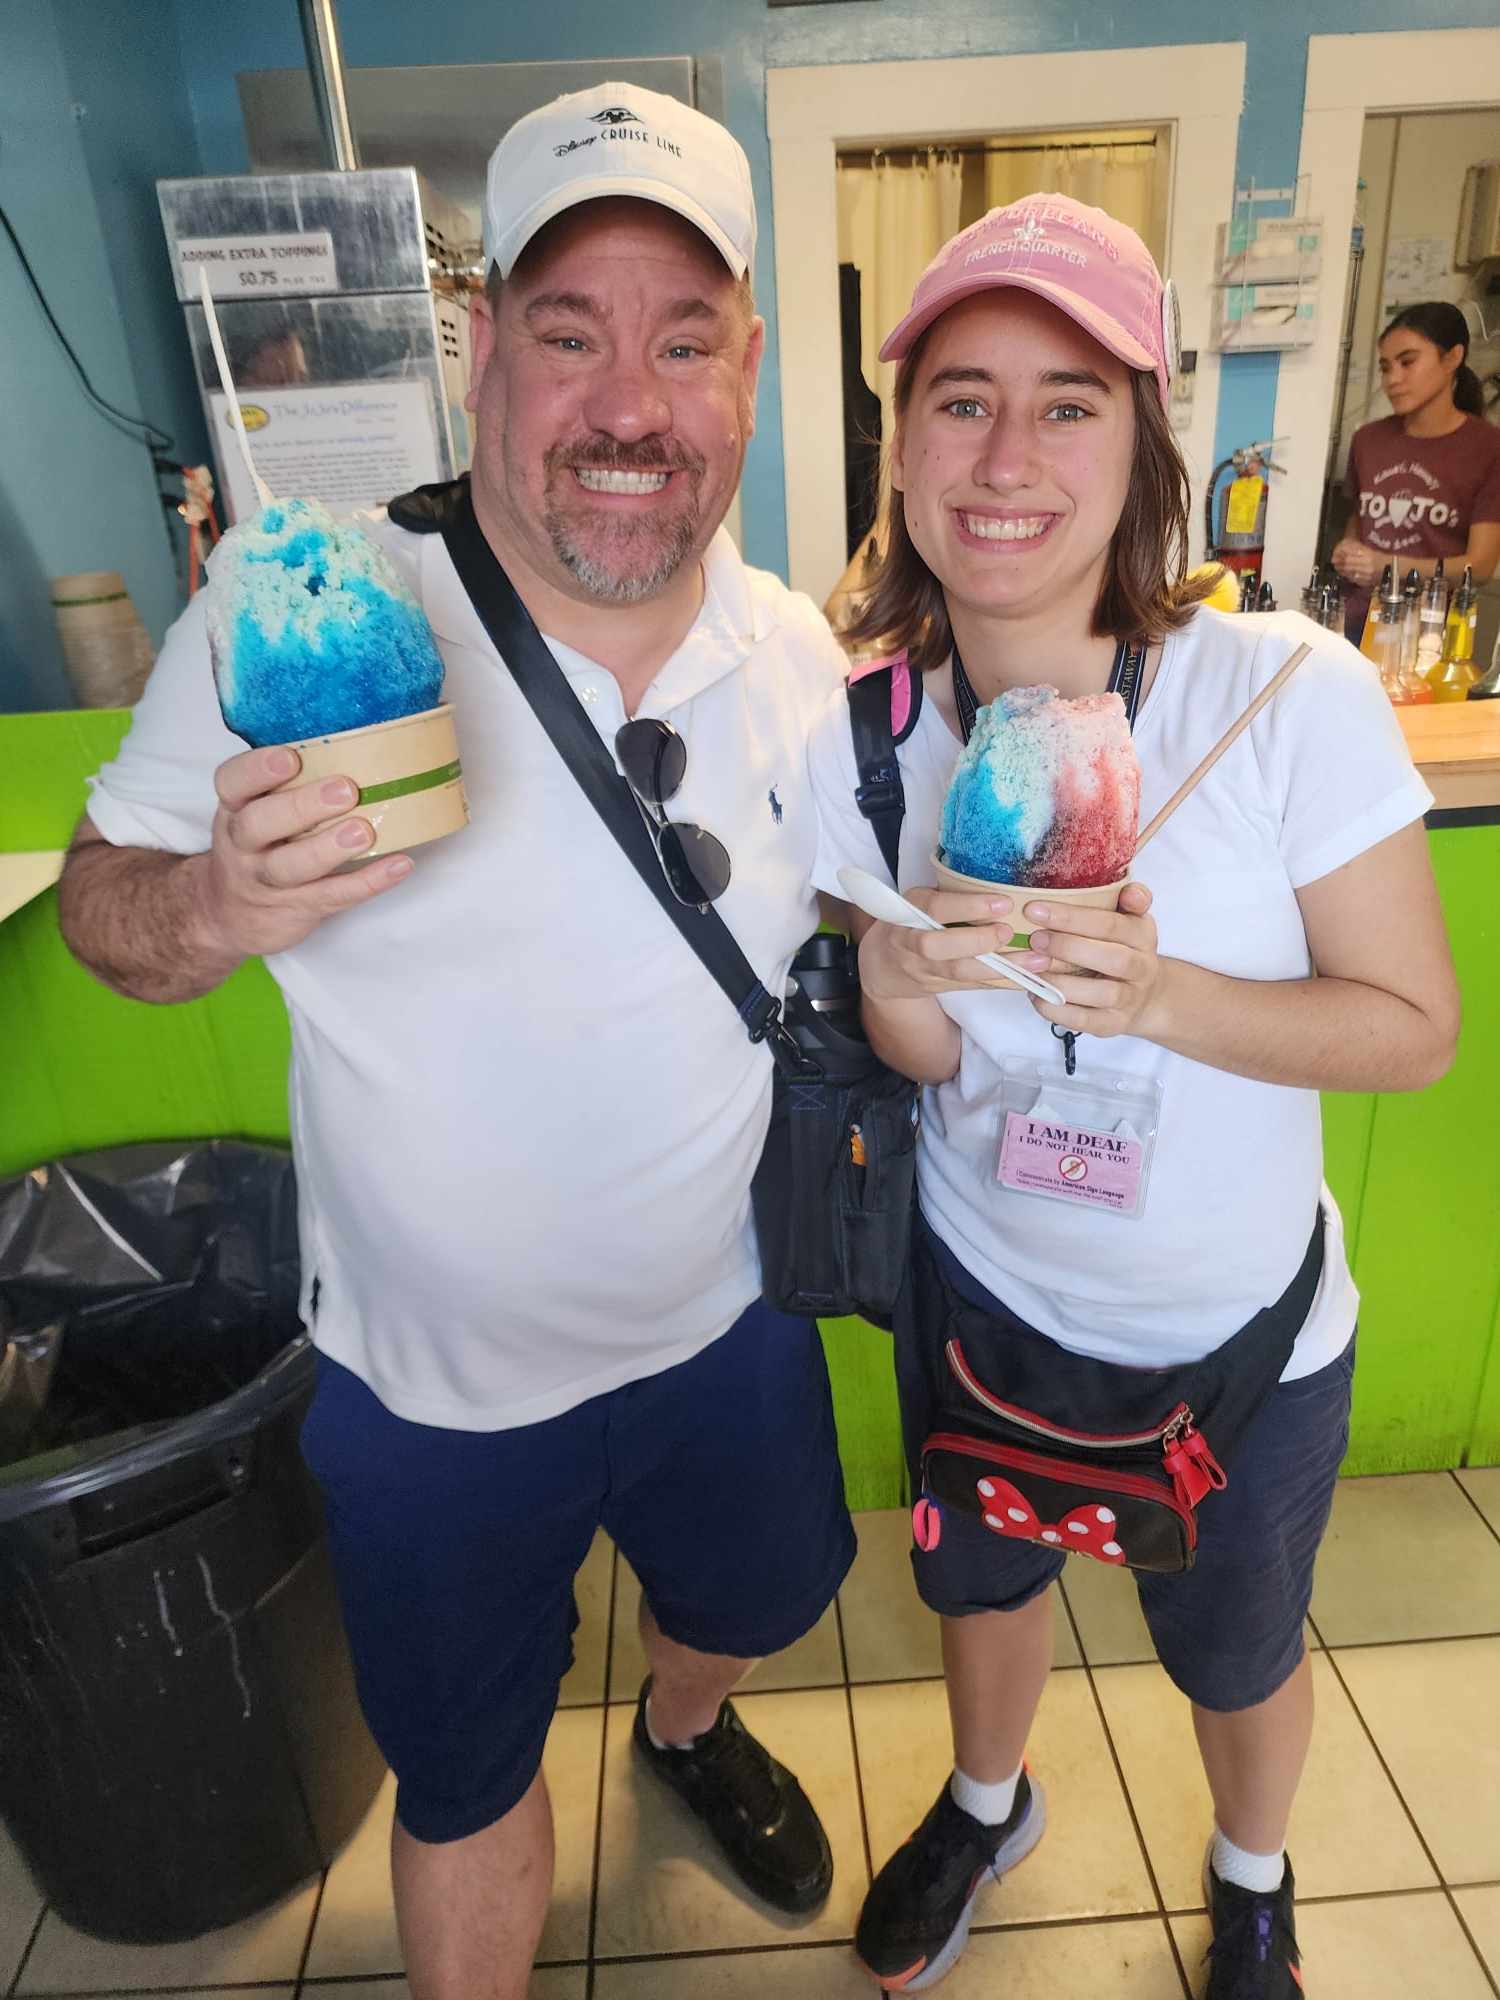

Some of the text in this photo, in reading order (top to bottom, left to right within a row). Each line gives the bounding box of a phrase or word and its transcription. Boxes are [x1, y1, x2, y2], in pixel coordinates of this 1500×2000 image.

[552, 127, 682, 159] Disney CRUISE LINE
[230, 248, 268, 260] EXTRA
[270, 245, 328, 259] TOPPINGS
[964, 241, 1088, 268] FRENCH QUARTER
[239, 271, 278, 286] $0.75
[1019, 1135, 1130, 1164] I DO NOT HEAR YOU
[1029, 1123, 1128, 1153] I AM DEAF
[1062, 1180, 1086, 1191] American
[1087, 1184, 1098, 1194] Sign
[1099, 1187, 1125, 1199] Language
